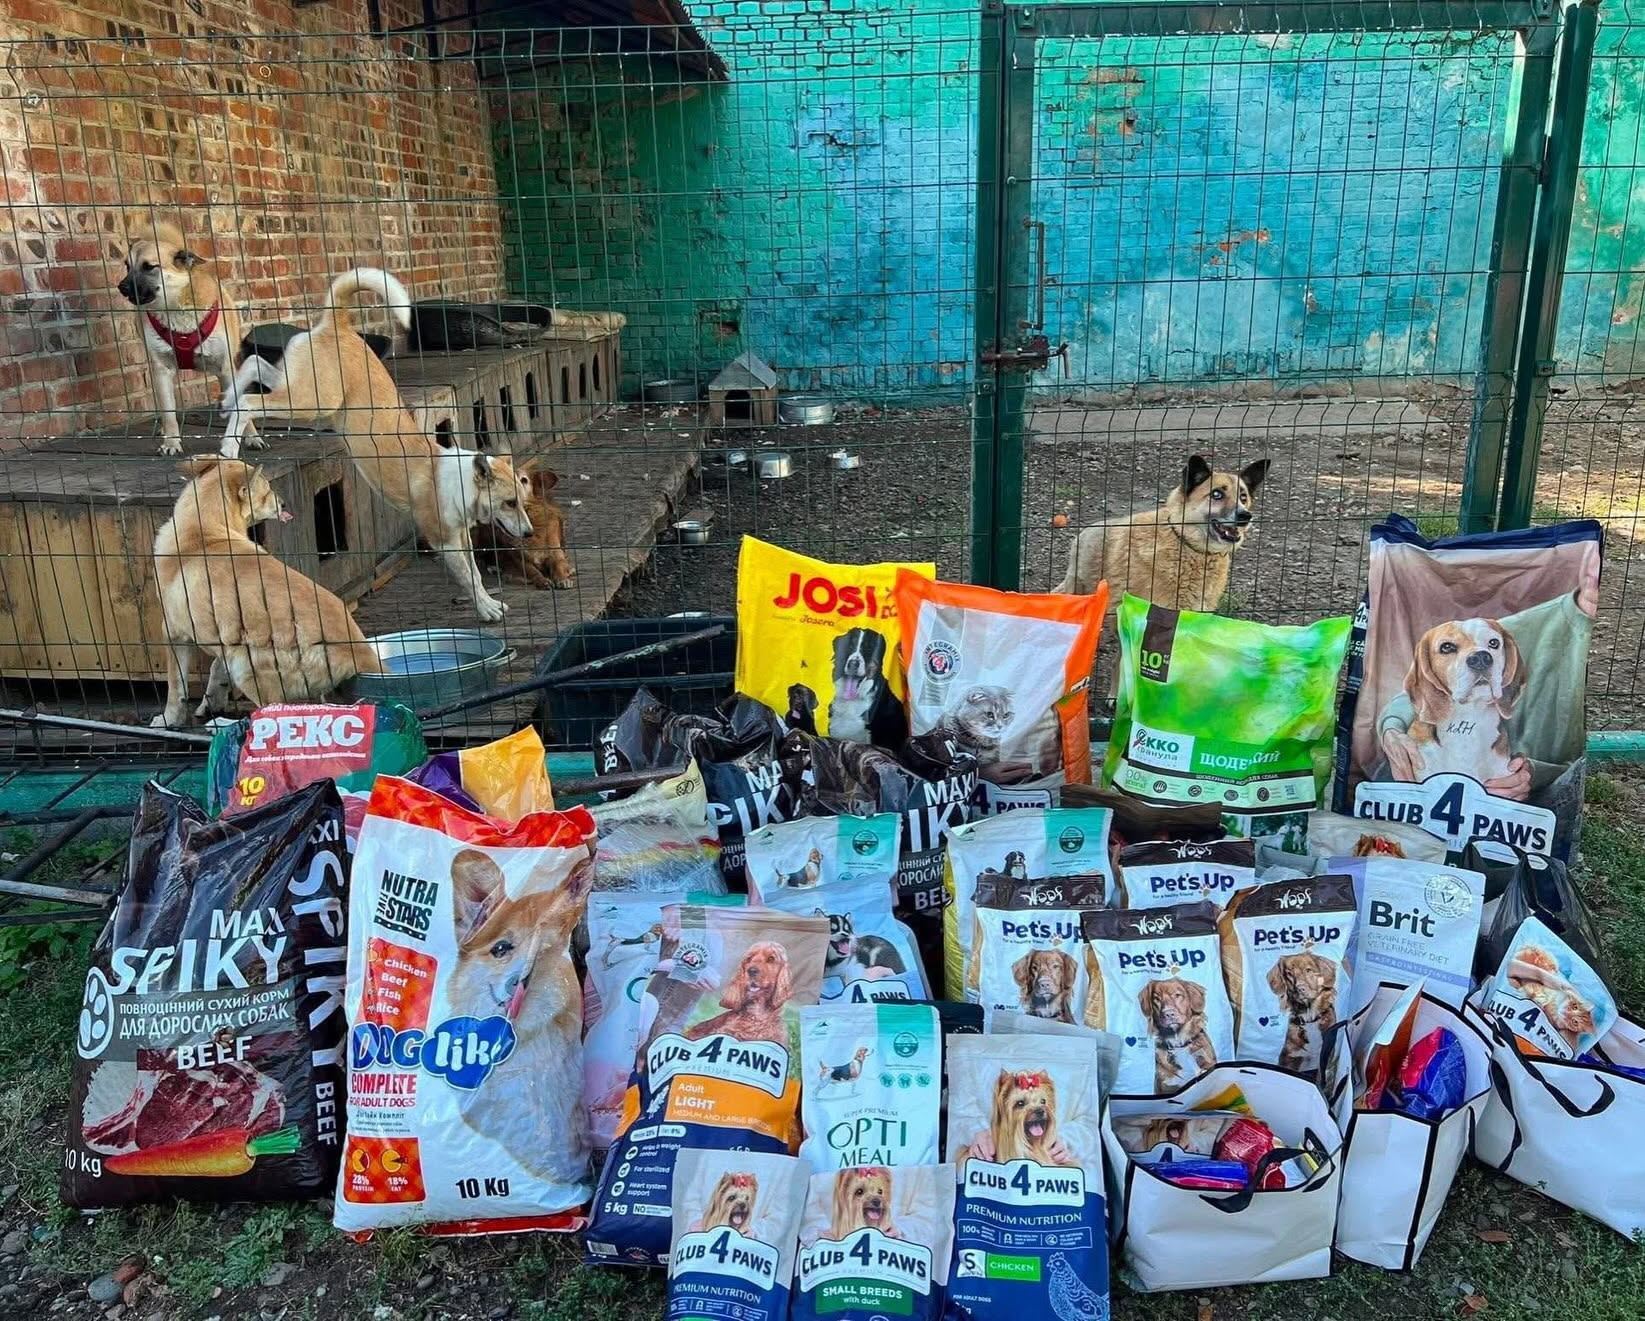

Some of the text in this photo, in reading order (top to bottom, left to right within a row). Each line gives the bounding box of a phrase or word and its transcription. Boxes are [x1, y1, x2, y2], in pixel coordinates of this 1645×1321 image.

[773, 572, 878, 618] JOSI
[1141, 650, 1162, 669] 10
[249, 714, 365, 750] РЕКС
[240, 776, 265, 796] 10
[746, 760, 783, 793] MA
[1360, 782, 1548, 851] CLUB 4 PAWS
[381, 869, 439, 907] NUTRA
[1150, 872, 1235, 893] Pet's Up
[385, 897, 433, 931] STARS
[1369, 900, 1436, 938] Brit
[1002, 920, 1051, 939] Pet's
[1254, 925, 1341, 946] Pet's Up
[1367, 932, 1426, 950] GRAIN FREE
[1118, 948, 1206, 968] Pet's Up
[1367, 940, 1450, 965] VETERINARY DIET
[111, 936, 288, 996] SPIKY
[384, 959, 428, 979] Chicken
[381, 972, 408, 987] Beef
[120, 988, 289, 1016] ПОВНОЦІННИЙ СУХИЙ КОРМ
[377, 987, 401, 1000] Fish
[376, 1002, 400, 1015] Rice
[1488, 1000, 1516, 1020] LUB
[1518, 1007, 1541, 1032] 4
[120, 1001, 290, 1040] ДЛЯ ДОРОСЛИХ СОБАК
[177, 1035, 253, 1070] BEEF
[650, 1036, 781, 1079] CLUB 4 PAWS
[352, 1073, 418, 1095] COMPLETE
[678, 1083, 704, 1094] Adult
[361, 1098, 389, 1108] ADULT
[390, 1098, 416, 1108] DOGS
[674, 1096, 715, 1110] LIGHT
[315, 1082, 339, 1147] BEEF
[722, 1115, 746, 1123] LARGE
[827, 1118, 907, 1150] OPTI
[65, 1148, 102, 1178] 10 kg
[839, 1147, 898, 1168] MEAL
[352, 1174, 370, 1185] 28%
[643, 1165, 671, 1173] sterilized
[387, 1176, 408, 1186] 18%
[456, 1177, 510, 1199] 10 Kg
[969, 1164, 1079, 1196] CLUB 4 PAWS
[604, 1202, 628, 1215] 5 kg
[966, 1203, 1082, 1226] PREMIUM NUTRITION
[709, 1231, 731, 1264] 4
[732, 1248, 773, 1276] PAWS
[802, 1233, 927, 1278] CLUB 4 PAWS
[964, 1252, 976, 1270] S
[990, 1261, 1034, 1271] CHICKEN
[710, 1287, 761, 1305] NUTRITION
[823, 1285, 903, 1299] SMALL BREEDS
[861, 1297, 880, 1305] duck
